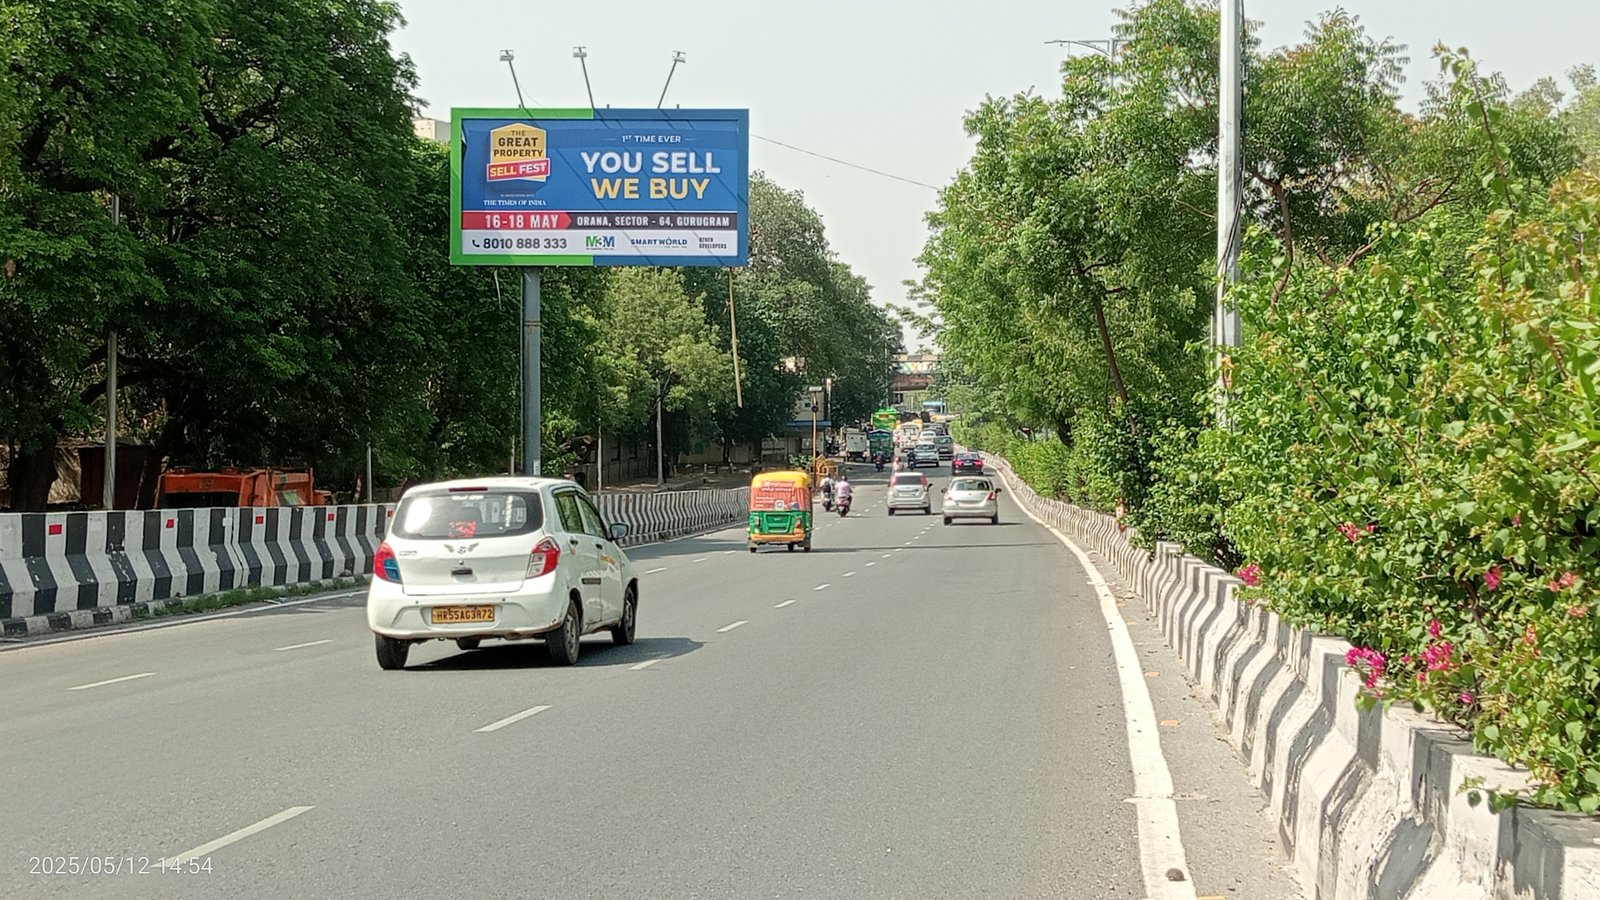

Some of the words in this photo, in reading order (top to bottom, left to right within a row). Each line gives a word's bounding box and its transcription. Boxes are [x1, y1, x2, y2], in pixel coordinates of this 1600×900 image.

[498, 137, 539, 147] GREAT
[493, 149, 544, 157] PROPERTY
[580, 151, 643, 174] YOU
[651, 151, 721, 174] SELL
[489, 166, 517, 177] SELL
[519, 162, 547, 175] FEST
[591, 178, 640, 199] WE
[650, 178, 710, 200] BUY
[485, 214, 525, 229] 16-18
[530, 214, 559, 229] MAY
[576, 216, 612, 227] ORANA,
[615, 216, 649, 226] SECTOR
[659, 216, 674, 227] 64,
[676, 216, 730, 226] GURUGRAM
[483, 238, 513, 249] 8010
[516, 238, 540, 249] 888
[543, 238, 568, 249] 333
